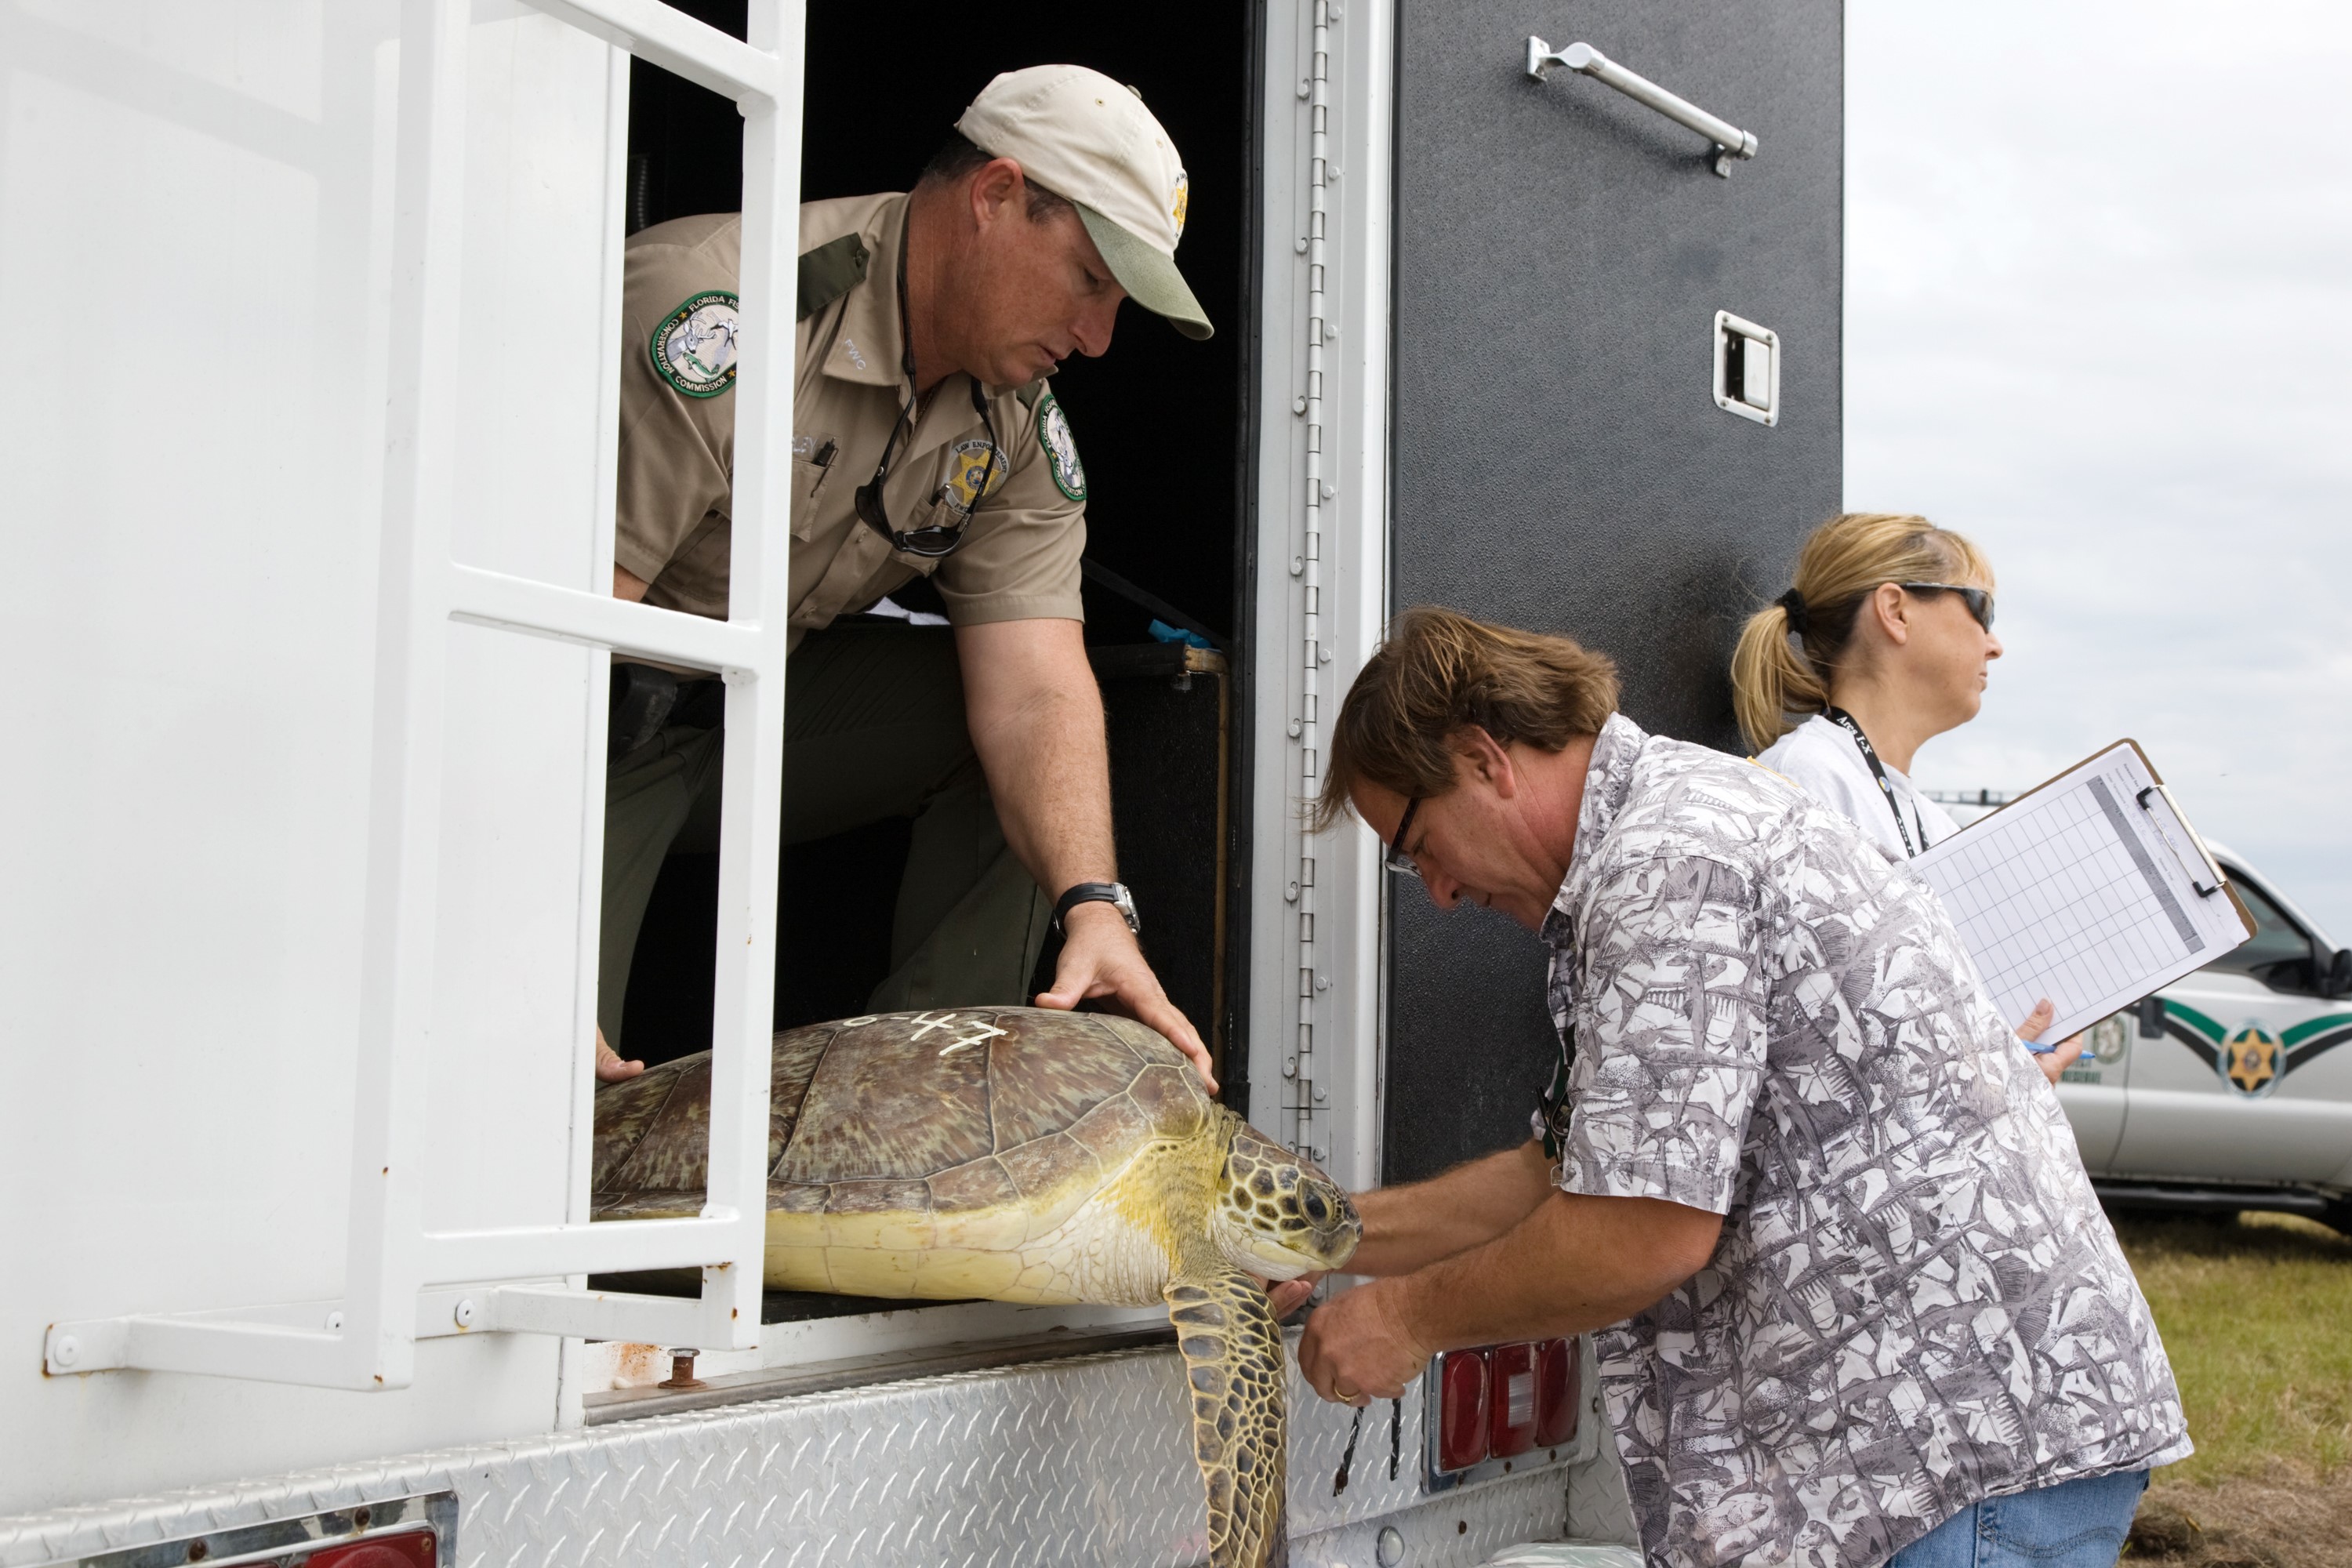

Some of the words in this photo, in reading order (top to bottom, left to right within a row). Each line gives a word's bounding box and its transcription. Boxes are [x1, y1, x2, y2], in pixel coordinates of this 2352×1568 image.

[688, 296, 725, 312] FLORIDA
[728, 298, 739, 310] FIS
[657, 318, 679, 374] CONSERVATION
[675, 376, 727, 392] COMMISSION
[1042, 415, 1051, 448] FLORIDA
[956, 442, 970, 454] LAW
[972, 441, 1007, 474] ENFOEMENT
[1055, 462, 1083, 496] CONSERVATION
